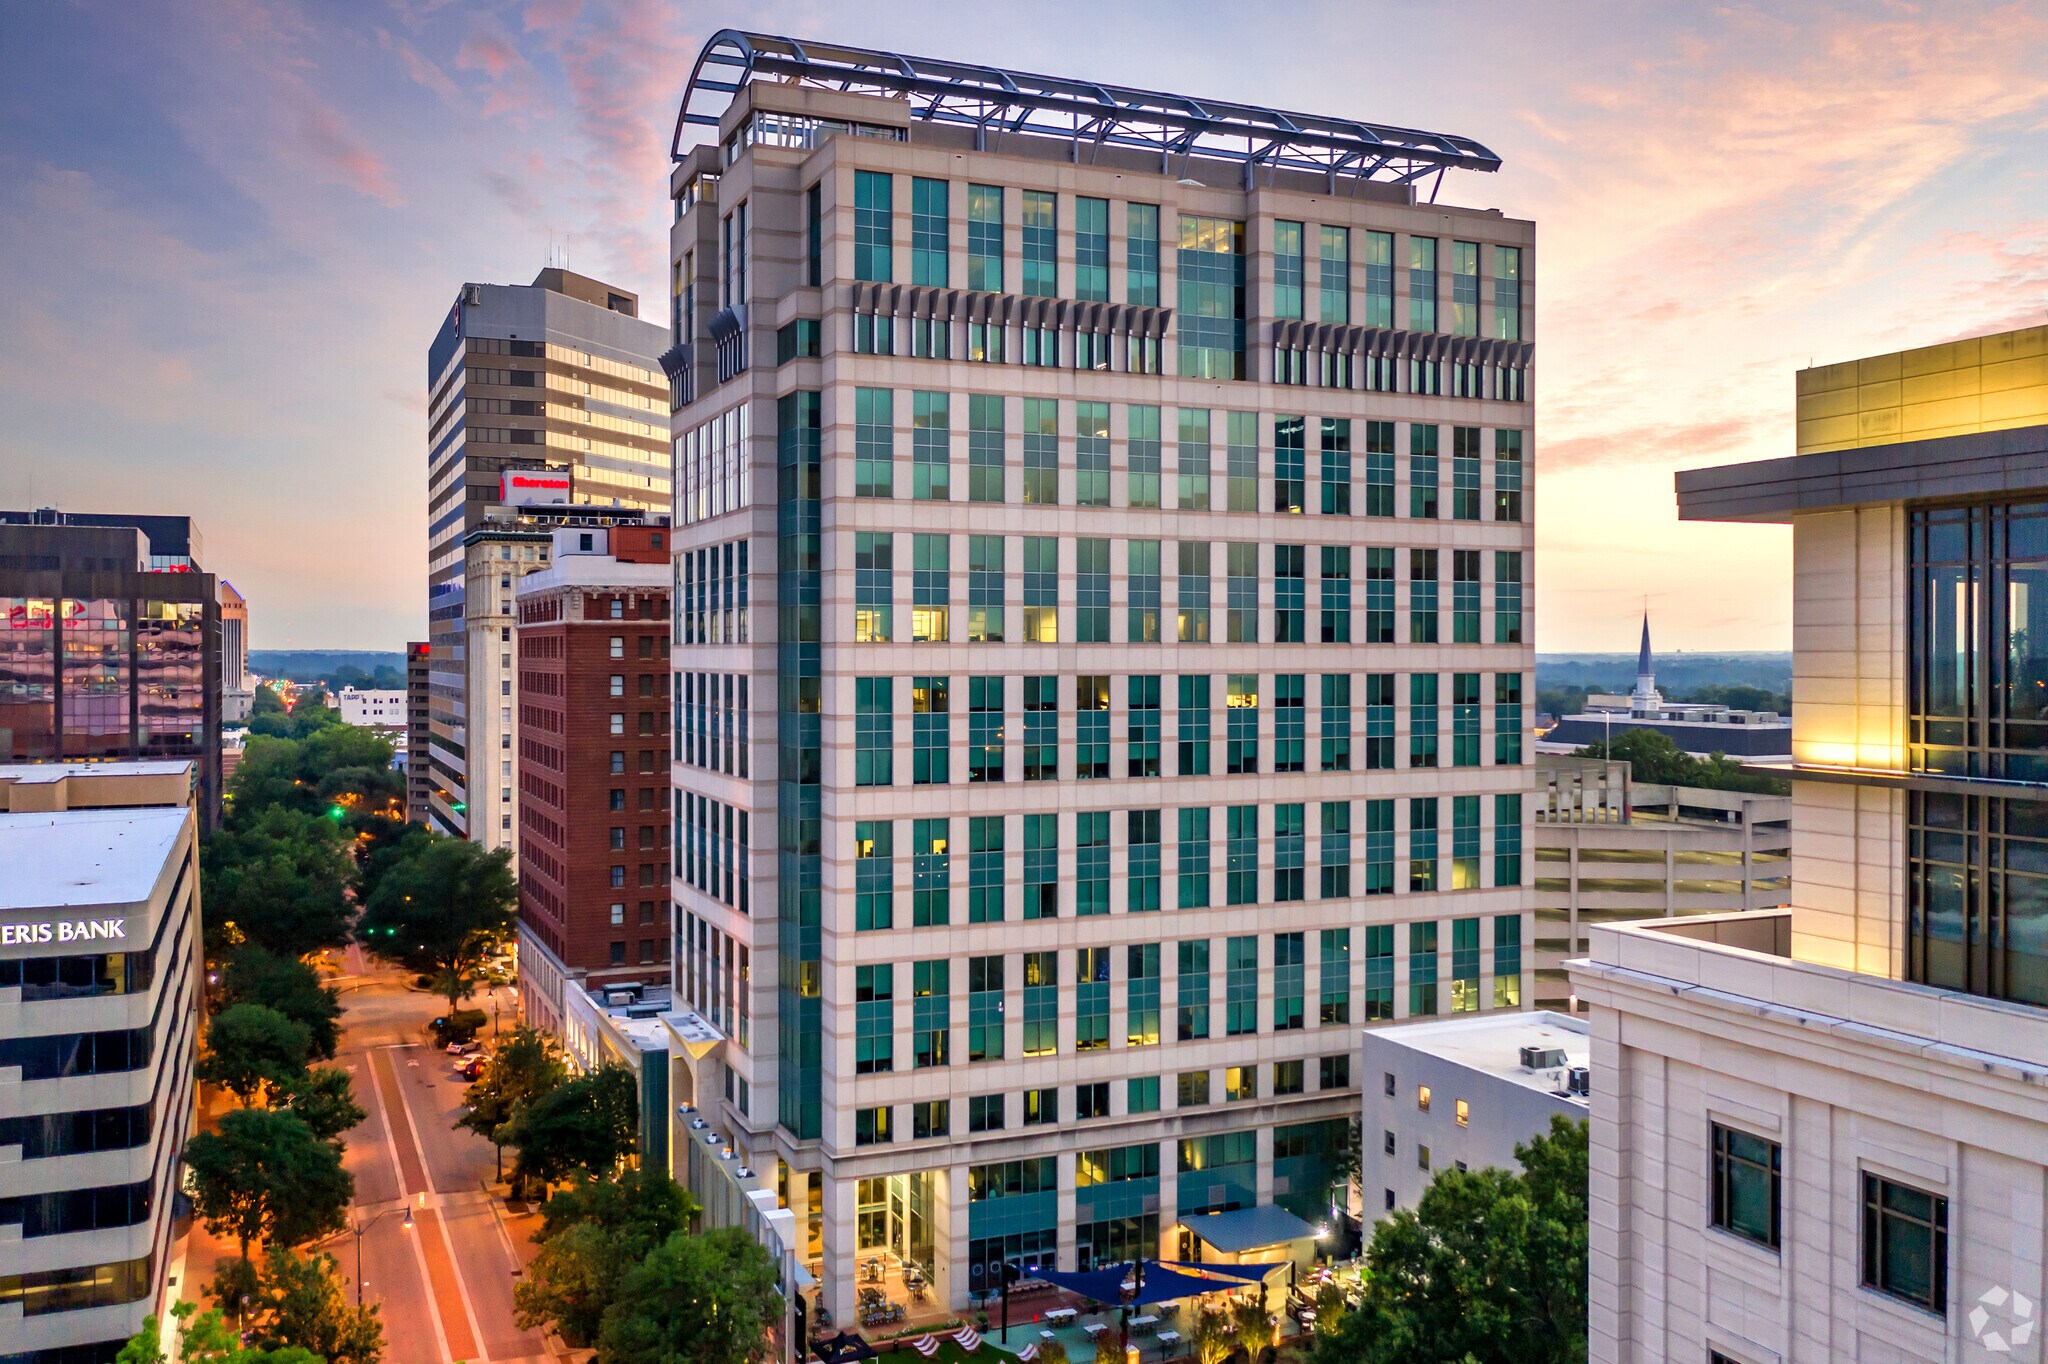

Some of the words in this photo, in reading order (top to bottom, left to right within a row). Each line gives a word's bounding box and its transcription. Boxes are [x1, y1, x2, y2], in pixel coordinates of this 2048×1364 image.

[512, 477, 569, 489] Sheraton
[0, 923, 53, 944] ERIS
[58, 919, 126, 942] BANK
